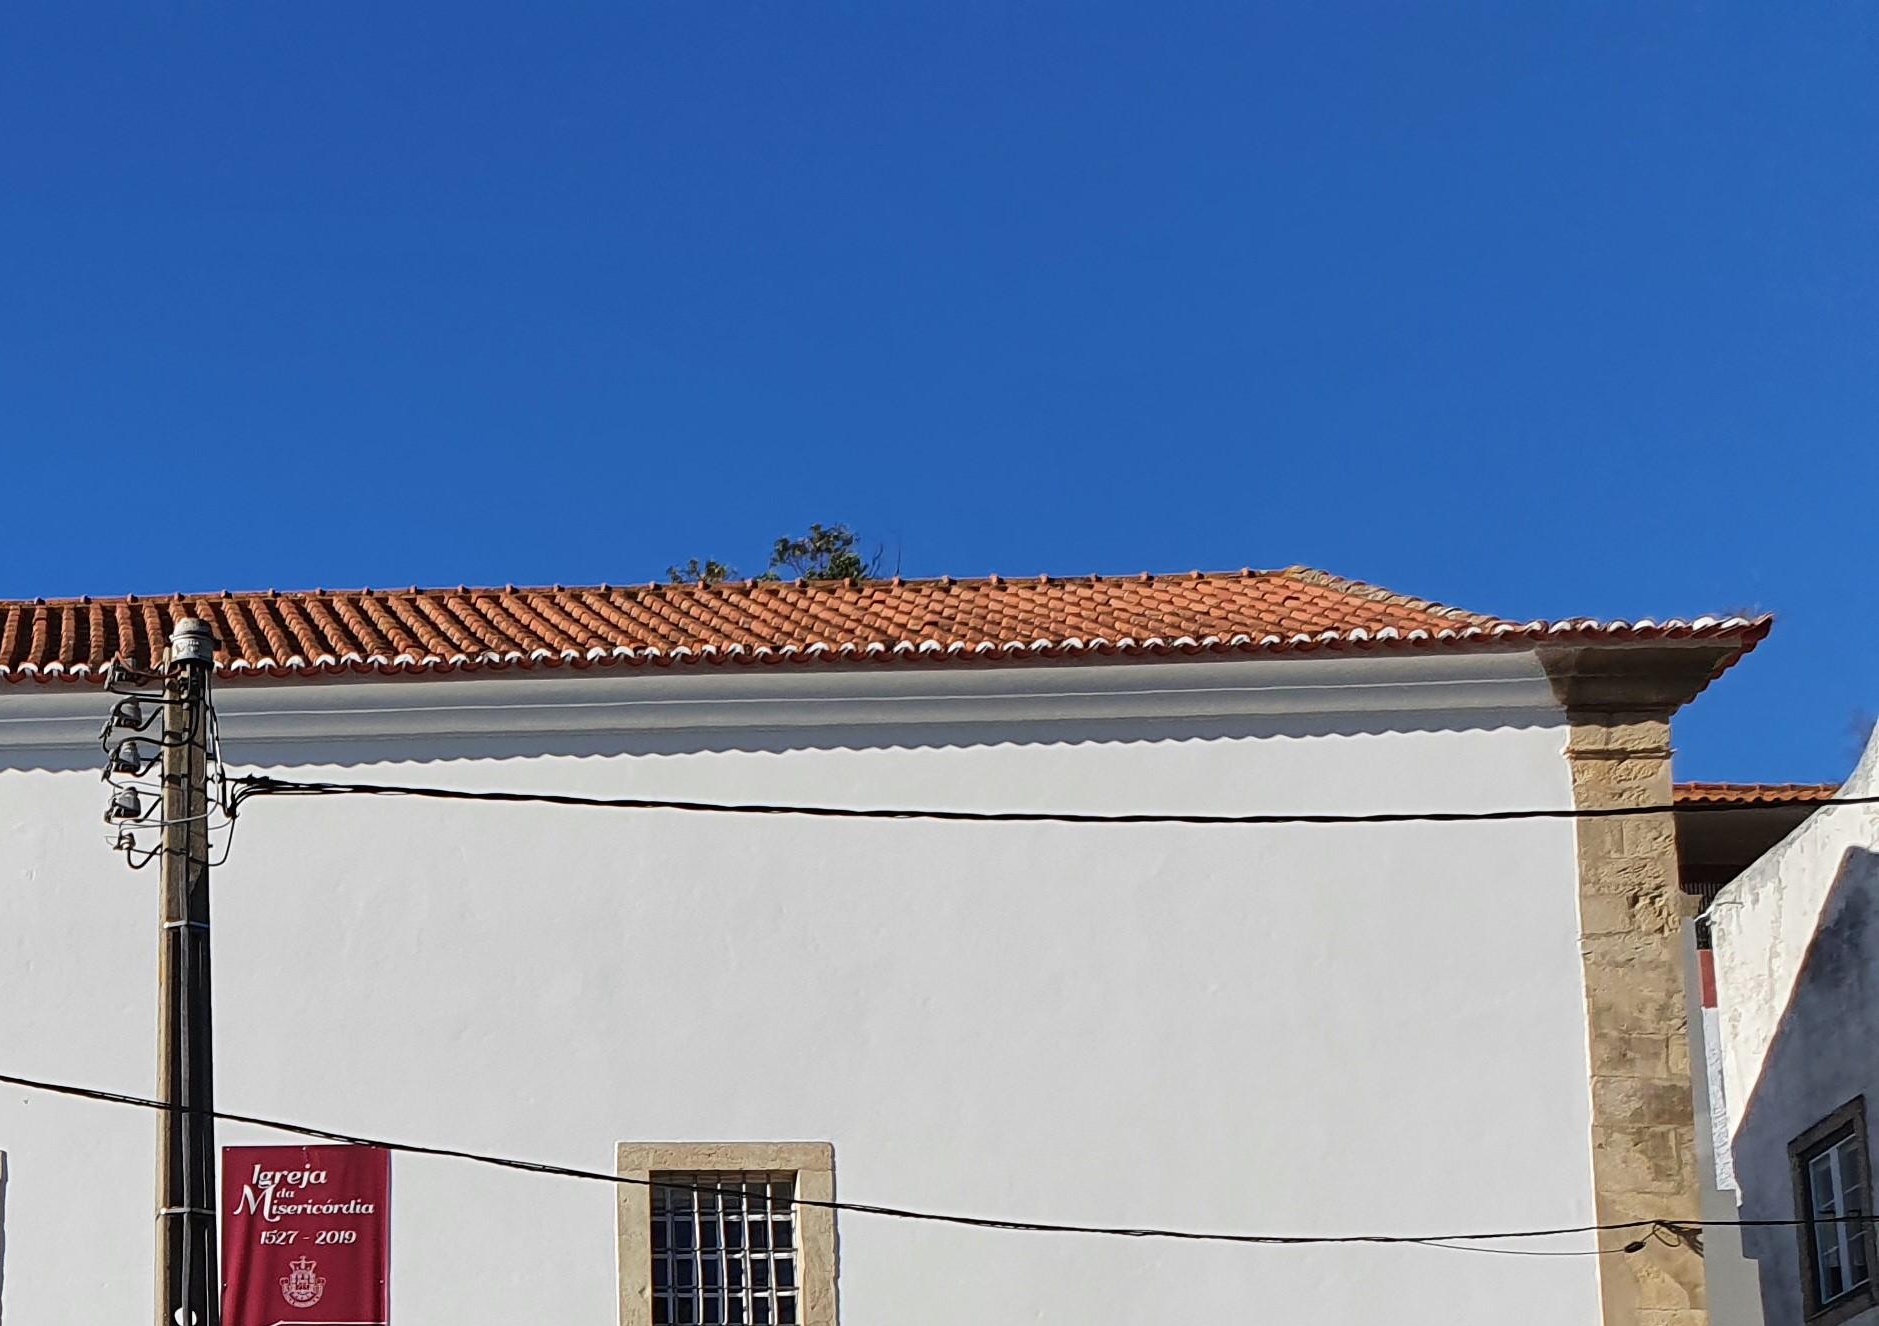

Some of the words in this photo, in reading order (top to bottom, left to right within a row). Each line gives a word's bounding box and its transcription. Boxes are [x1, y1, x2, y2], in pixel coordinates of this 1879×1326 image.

[252, 1163, 328, 1189] Igreja
[233, 1184, 375, 1222] Misericórdia
[276, 1188, 295, 1198] da
[260, 1230, 299, 1245] 1527
[315, 1230, 357, 1245] 2019
